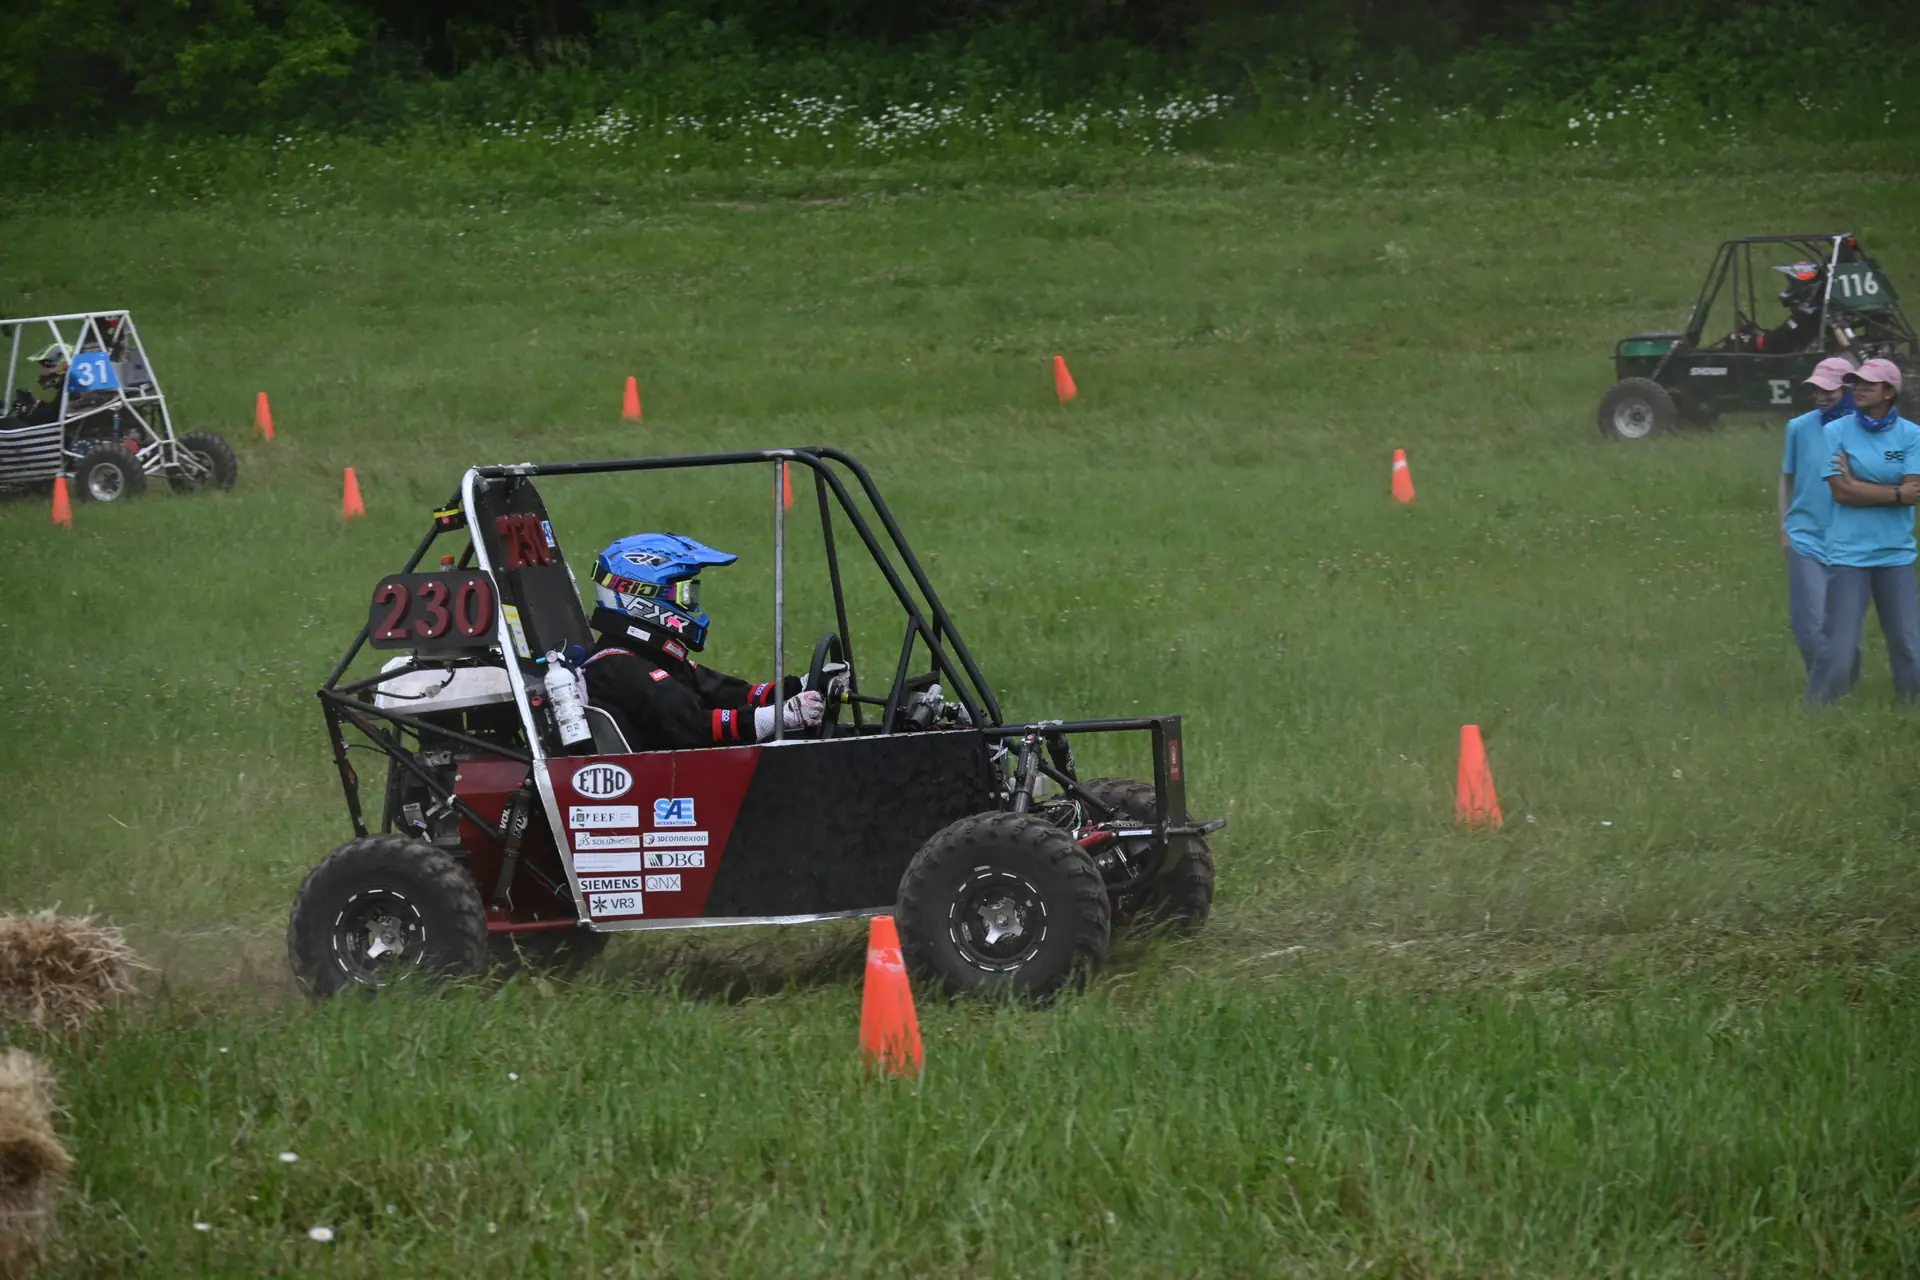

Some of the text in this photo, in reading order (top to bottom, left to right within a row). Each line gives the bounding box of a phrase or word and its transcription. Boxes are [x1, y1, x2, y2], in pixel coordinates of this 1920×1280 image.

[1838, 271, 1879, 297] 116
[77, 360, 108, 386] 31
[1768, 380, 1793, 404] E
[374, 578, 492, 640] 230
[626, 597, 691, 634] FXR
[578, 767, 625, 795] ETBO
[655, 800, 693, 820] SAE
[660, 853, 703, 867] DBG
[581, 878, 639, 890] SIEMENS
[646, 876, 680, 889] QNX
[610, 897, 635, 909] VR3
